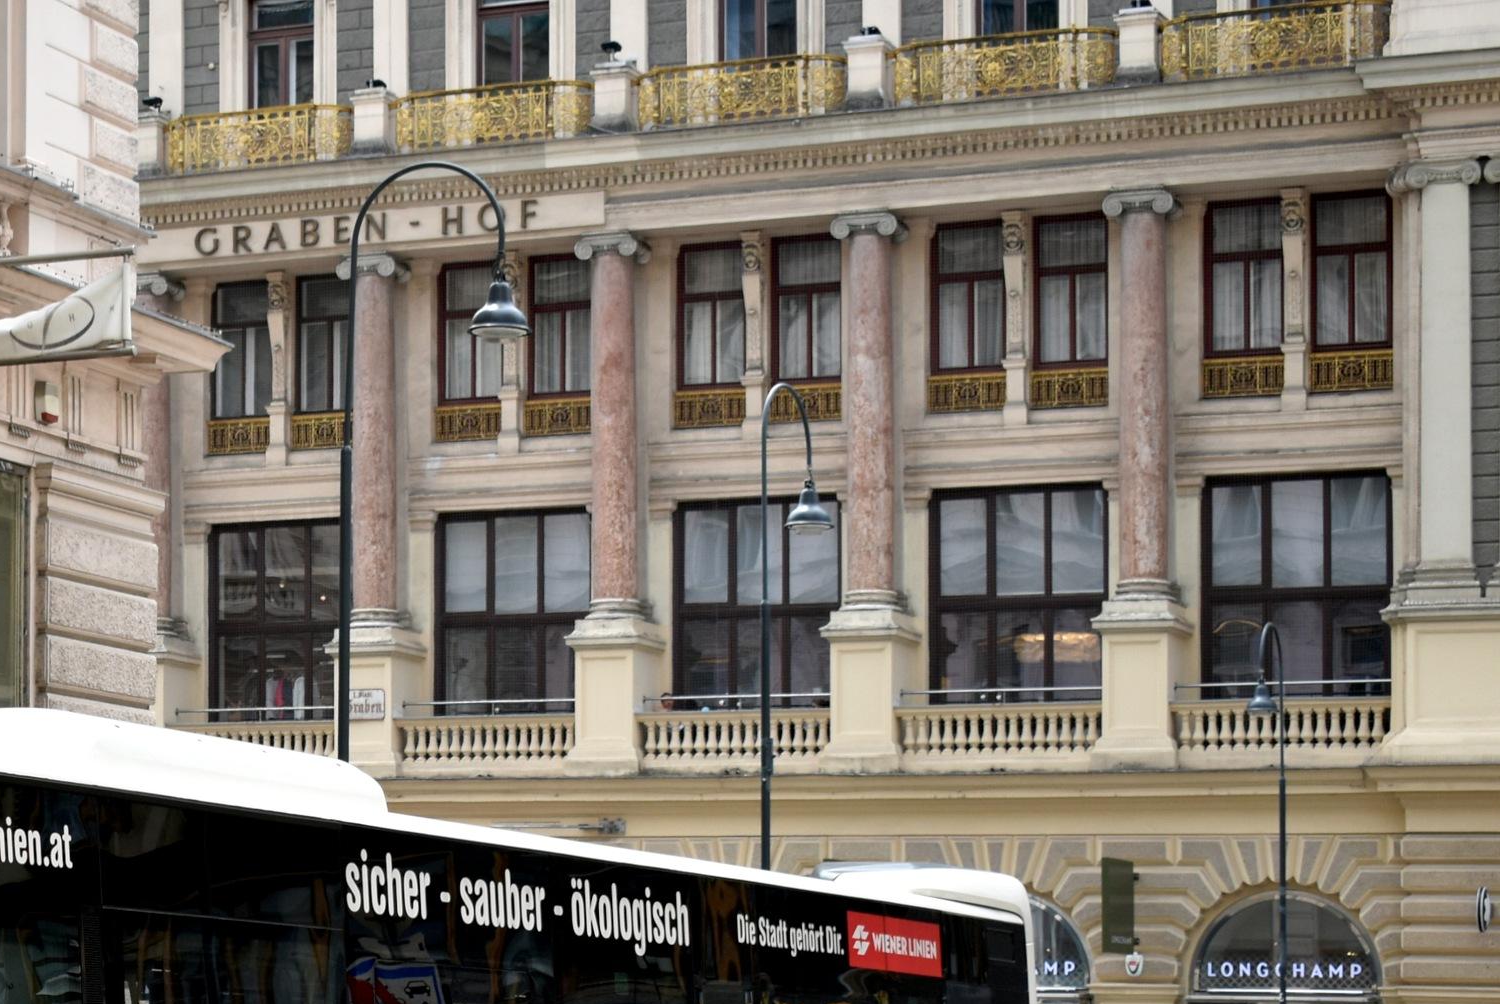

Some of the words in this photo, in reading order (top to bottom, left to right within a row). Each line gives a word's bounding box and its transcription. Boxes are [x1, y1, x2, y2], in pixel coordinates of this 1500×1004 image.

[194, 212, 387, 256] GRABEN
[441, 199, 539, 236] HOF
[345, 848, 431, 921] sicher
[440, 891, 450, 903] -
[460, 868, 546, 932] sauber
[554, 905, 564, 916] -
[570, 877, 691, 957] ökologisch
[736, 913, 756, 946] Die
[757, 915, 789, 949] Stadt
[789, 922, 825, 957] gehört
[825, 925, 845, 956] Dir.
[871, 931, 908, 956] WIENER
[908, 937, 938, 960] LINIEN
[1034, 961, 1076, 976] MP
